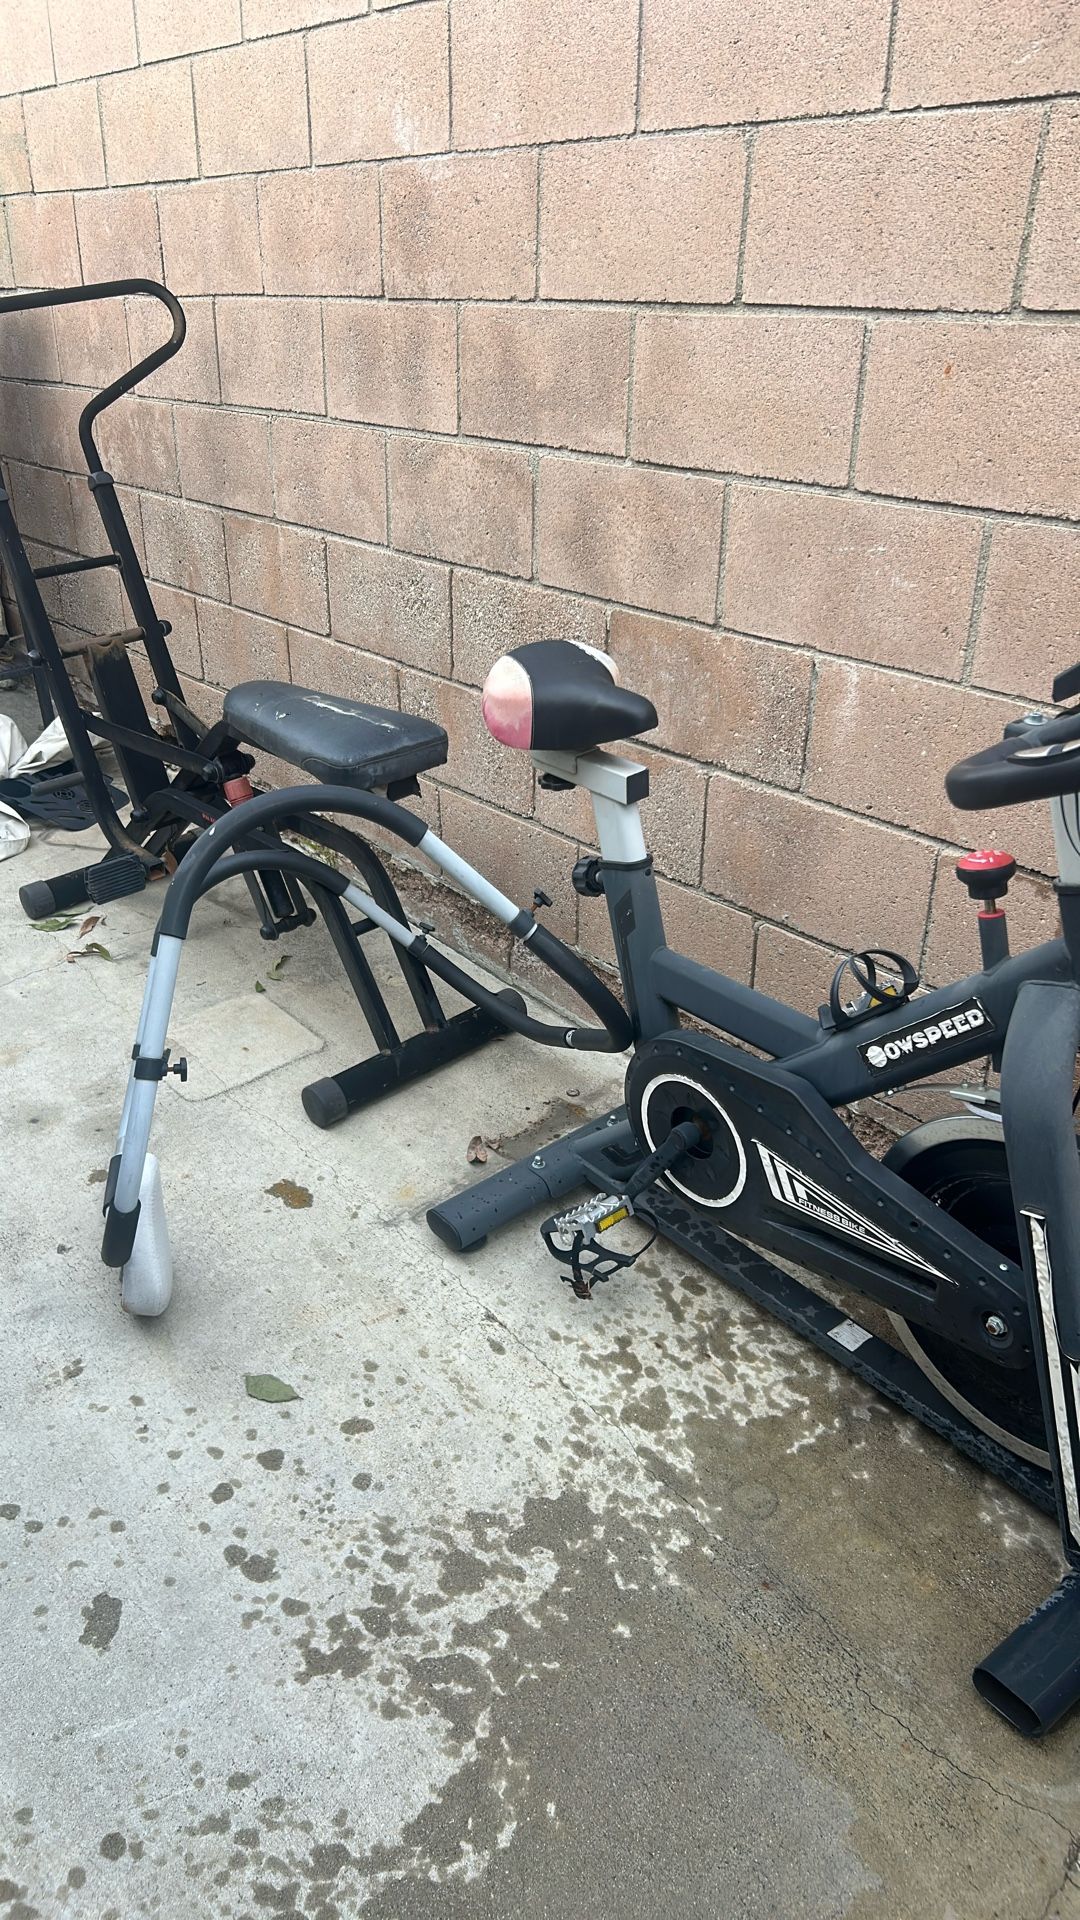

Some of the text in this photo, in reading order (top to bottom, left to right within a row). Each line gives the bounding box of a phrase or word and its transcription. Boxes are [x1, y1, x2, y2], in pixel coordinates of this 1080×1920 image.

[865, 1008, 985, 1068] OWSPEED
[798, 1197, 866, 1235] FITNESS BIKE
